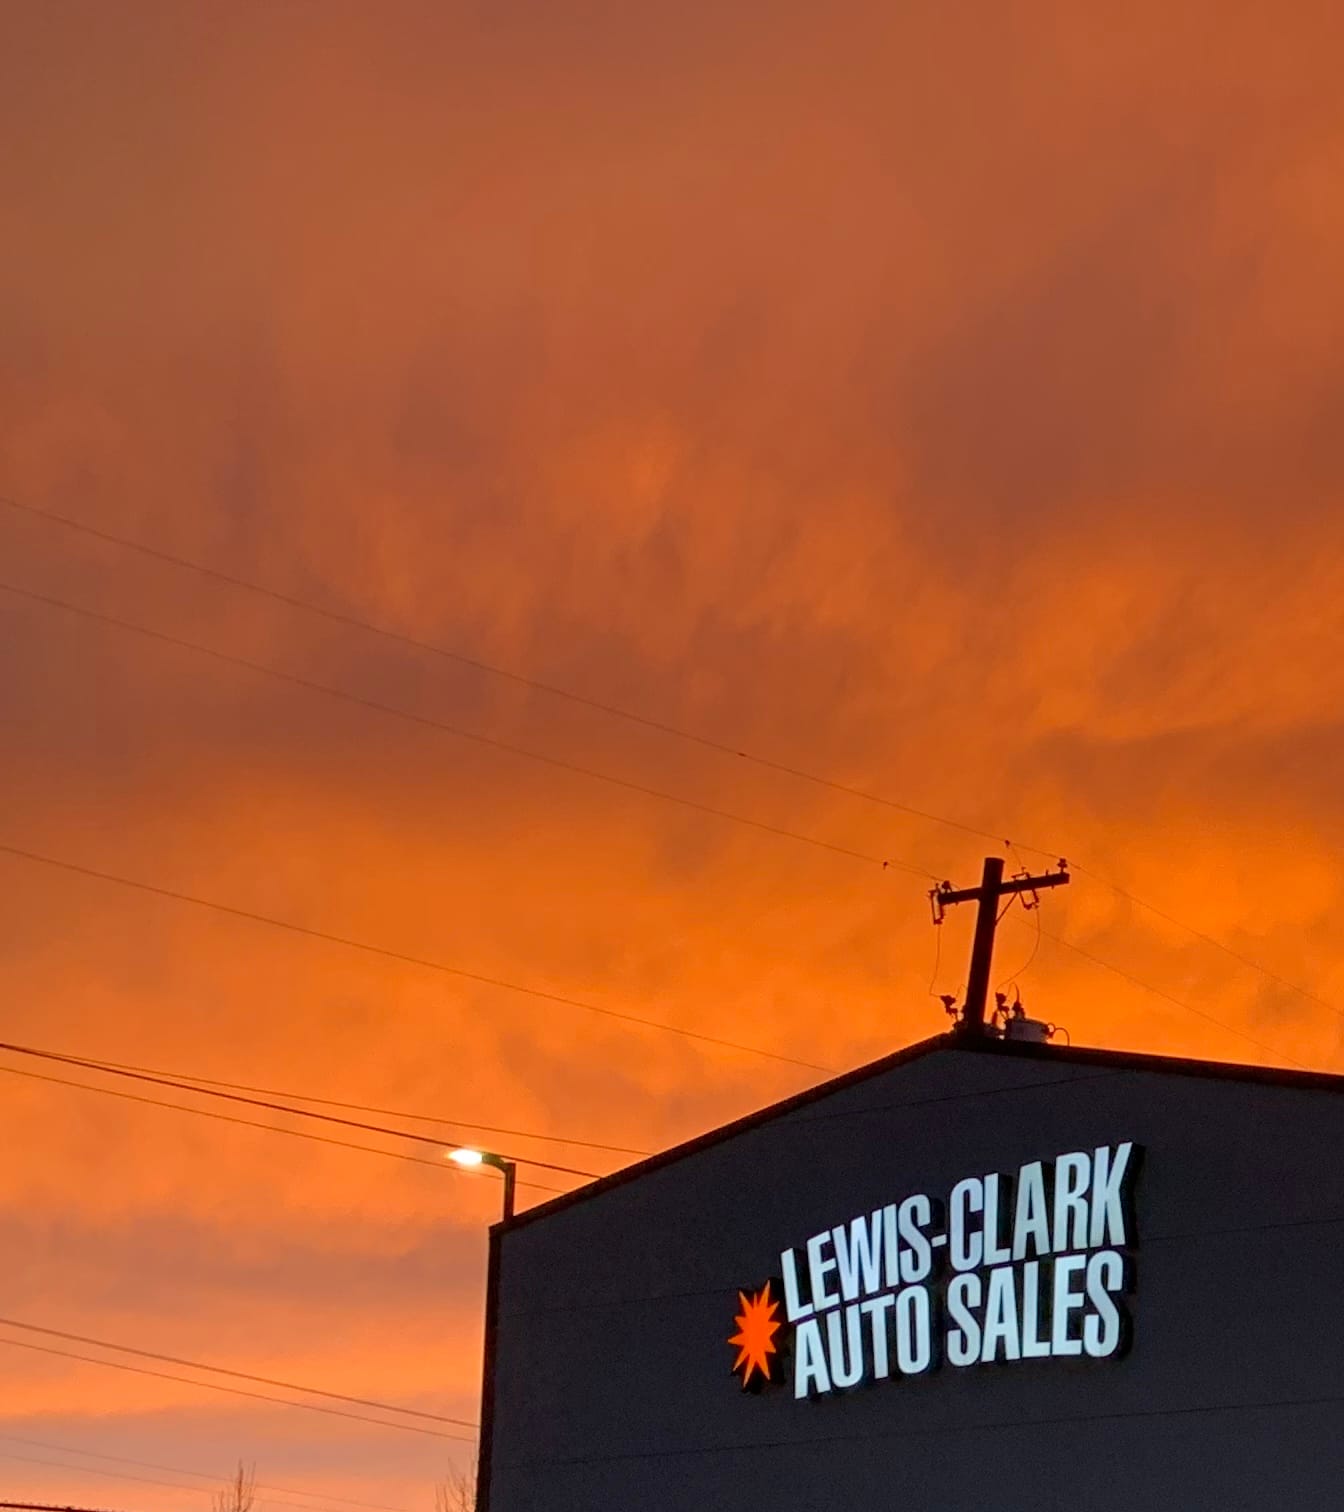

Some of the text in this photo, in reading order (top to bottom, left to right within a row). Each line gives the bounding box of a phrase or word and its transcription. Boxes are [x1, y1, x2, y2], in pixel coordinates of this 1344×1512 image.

[780, 1141, 1133, 1323] LEWIS-CLARK
[794, 1250, 1124, 1400] AUTO SALES
